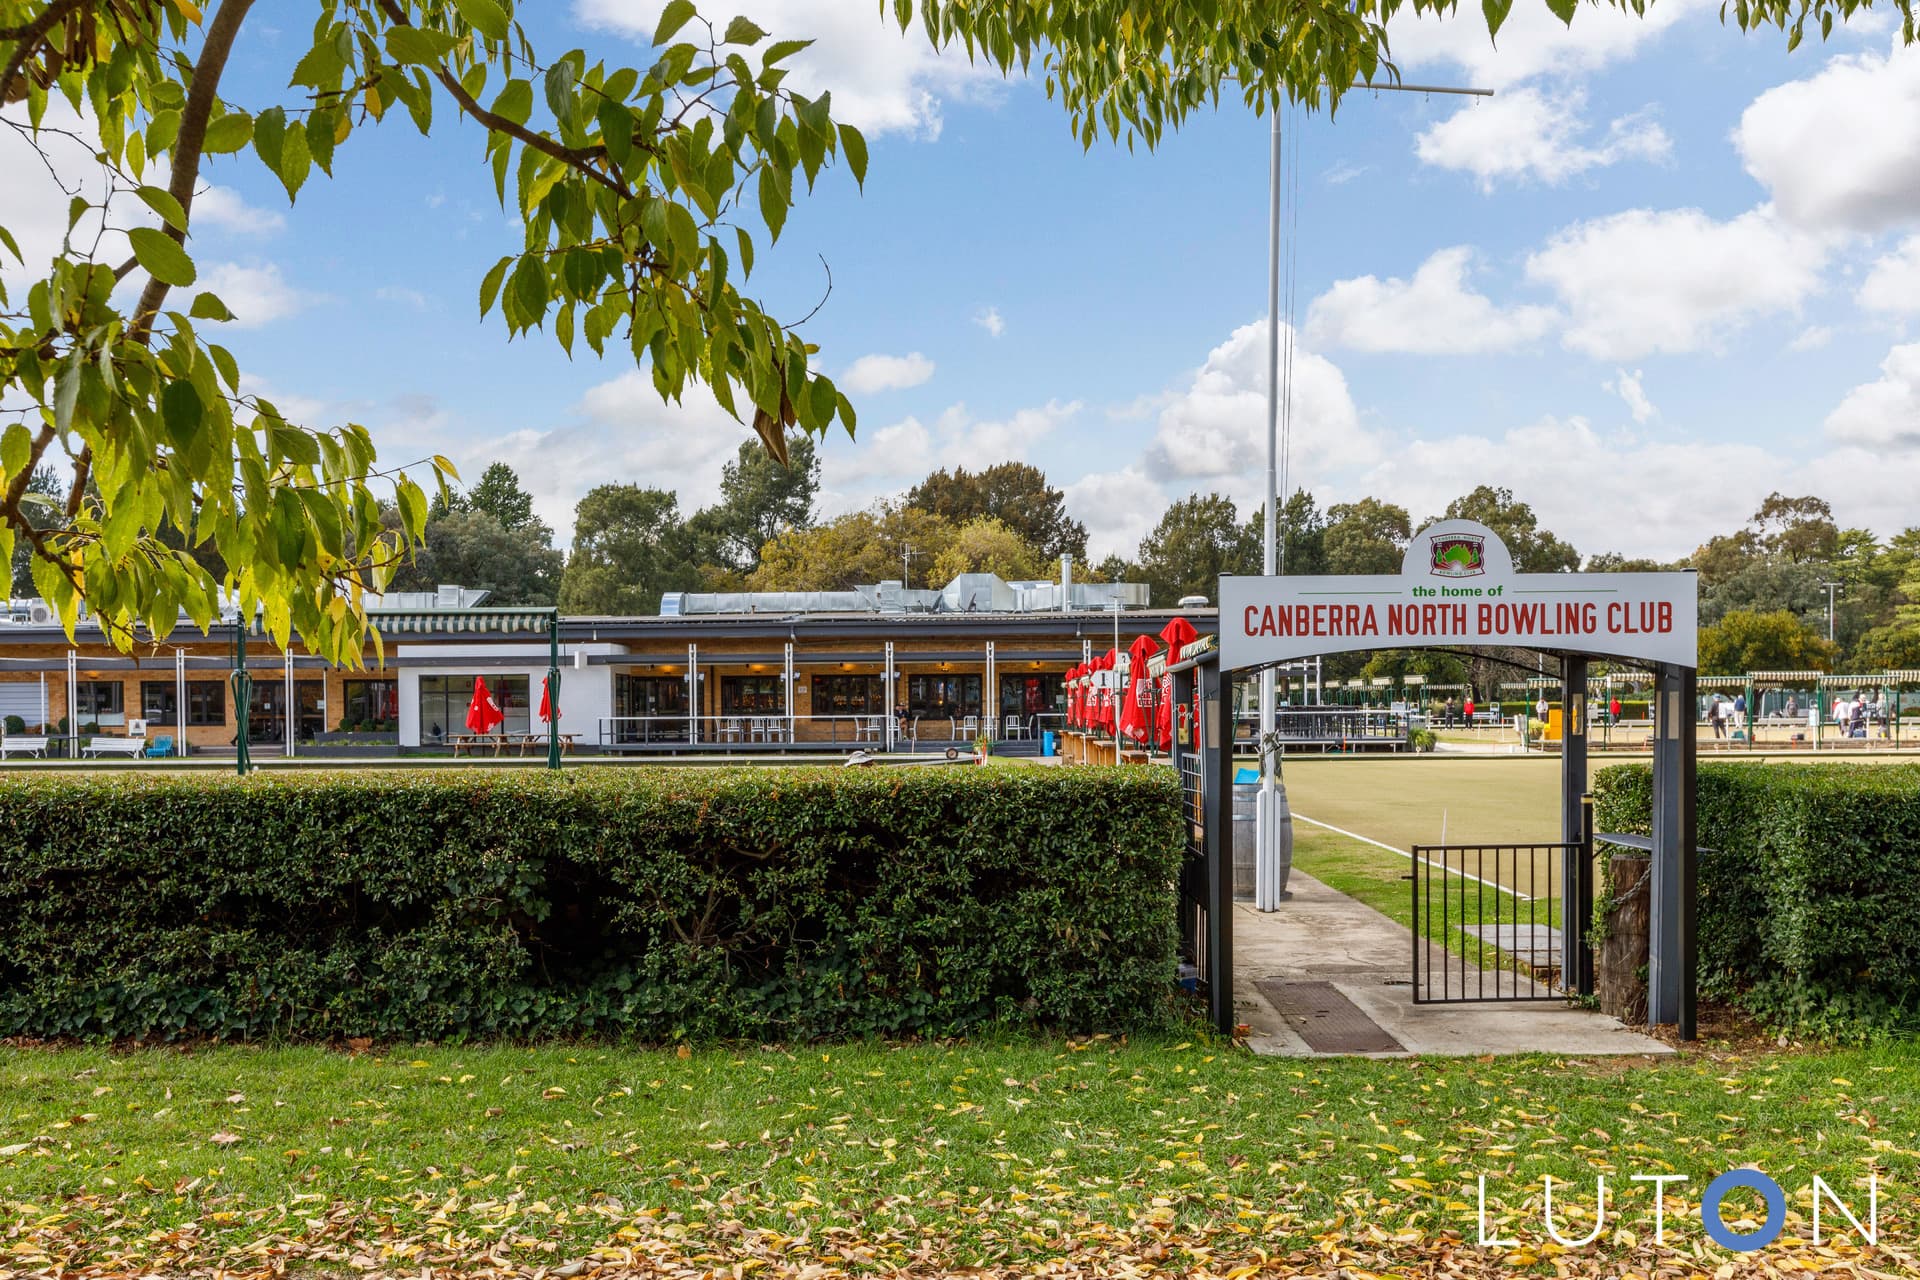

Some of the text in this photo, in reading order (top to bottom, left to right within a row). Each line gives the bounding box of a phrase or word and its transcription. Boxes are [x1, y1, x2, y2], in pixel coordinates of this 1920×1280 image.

[1412, 585, 1503, 597] the home of
[1244, 602, 1673, 637] CANBERRA NORTH BOWLING CLUB
